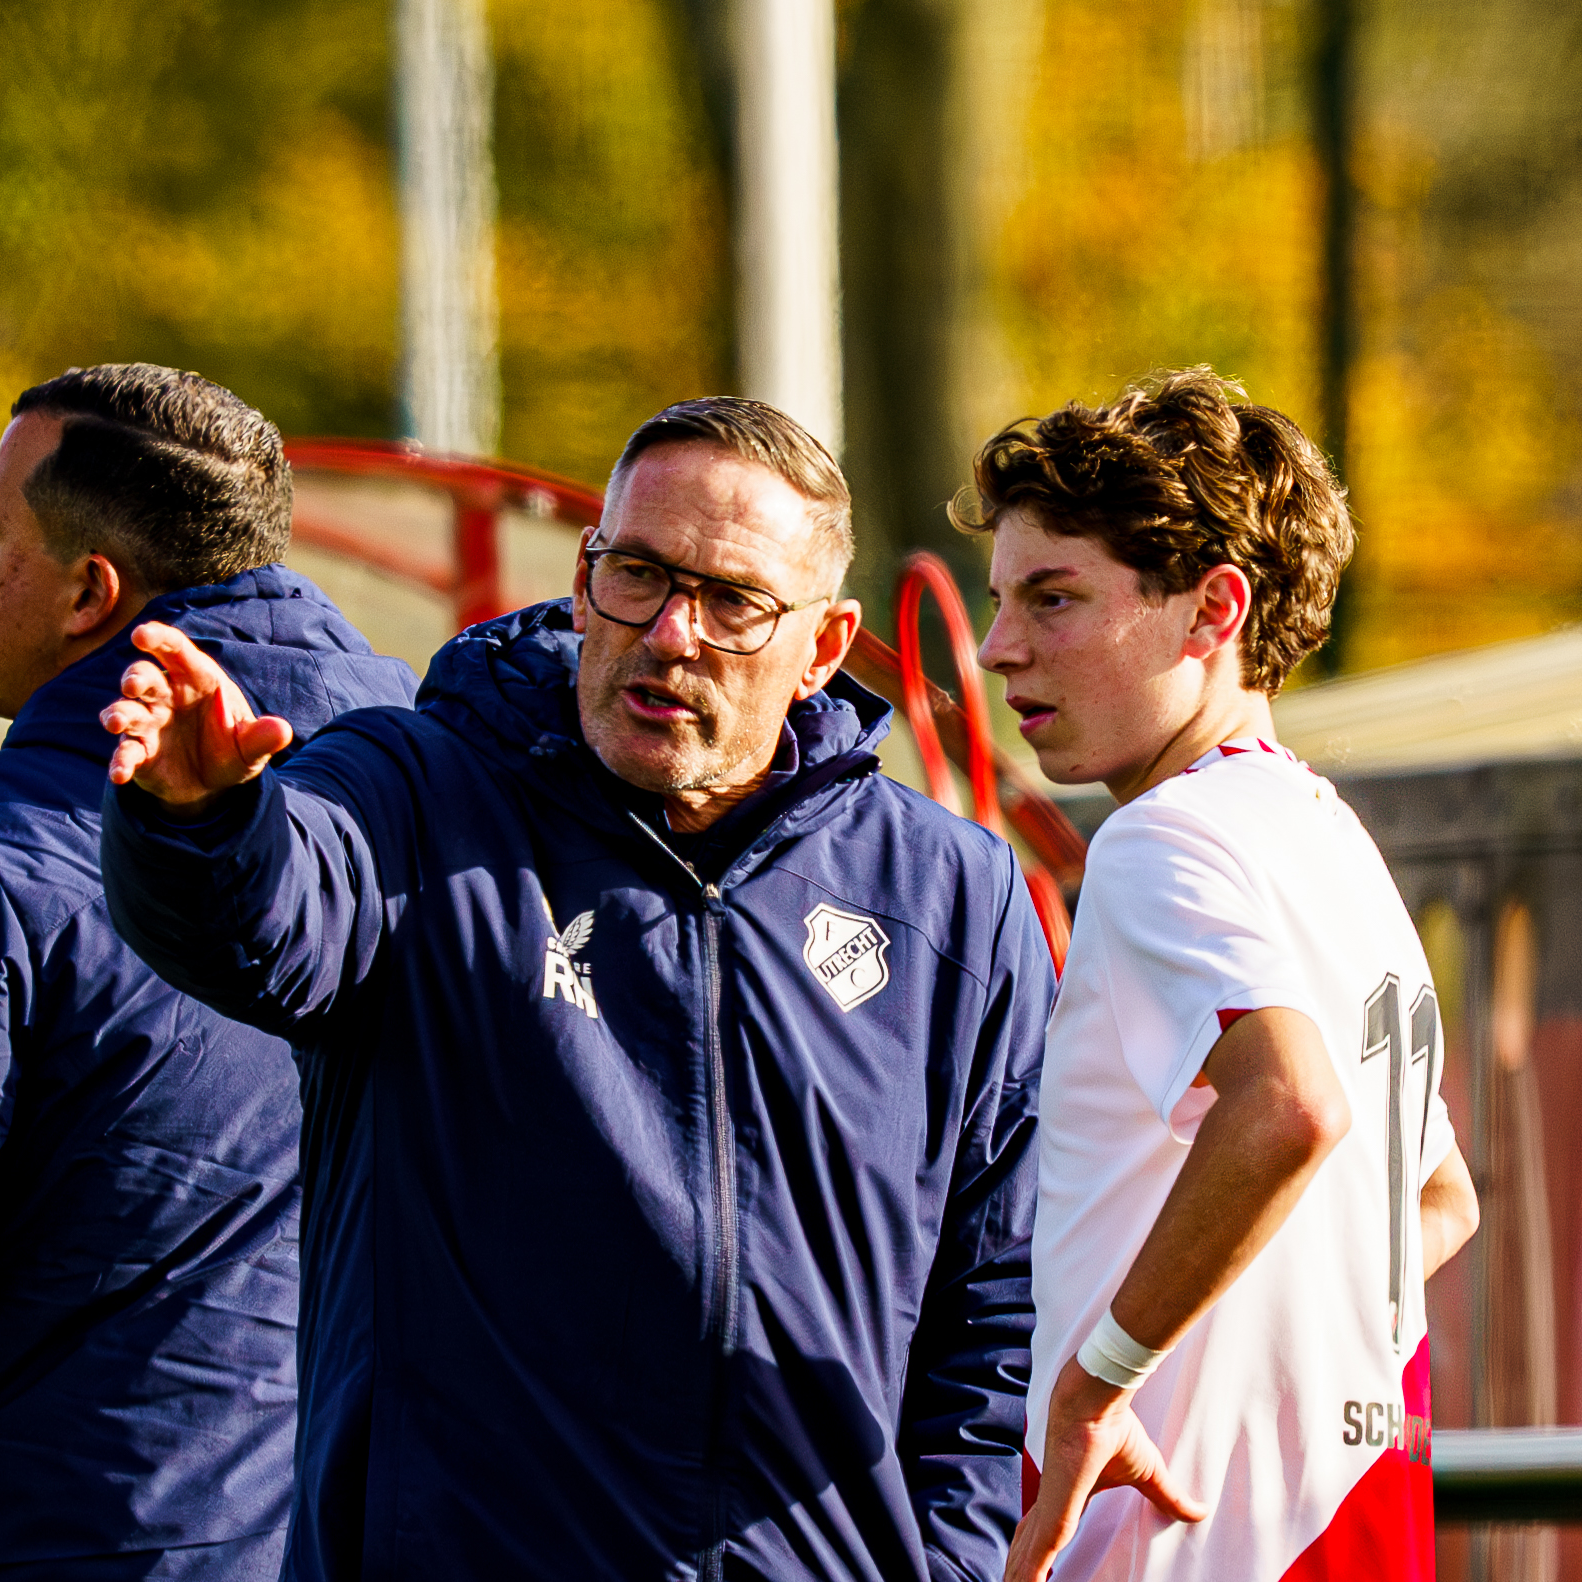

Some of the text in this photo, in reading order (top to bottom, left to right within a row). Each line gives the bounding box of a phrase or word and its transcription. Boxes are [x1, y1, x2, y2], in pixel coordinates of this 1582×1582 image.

[824, 920, 837, 942] F
[815, 925, 879, 984] UTRECHT
[849, 966, 866, 990] C
